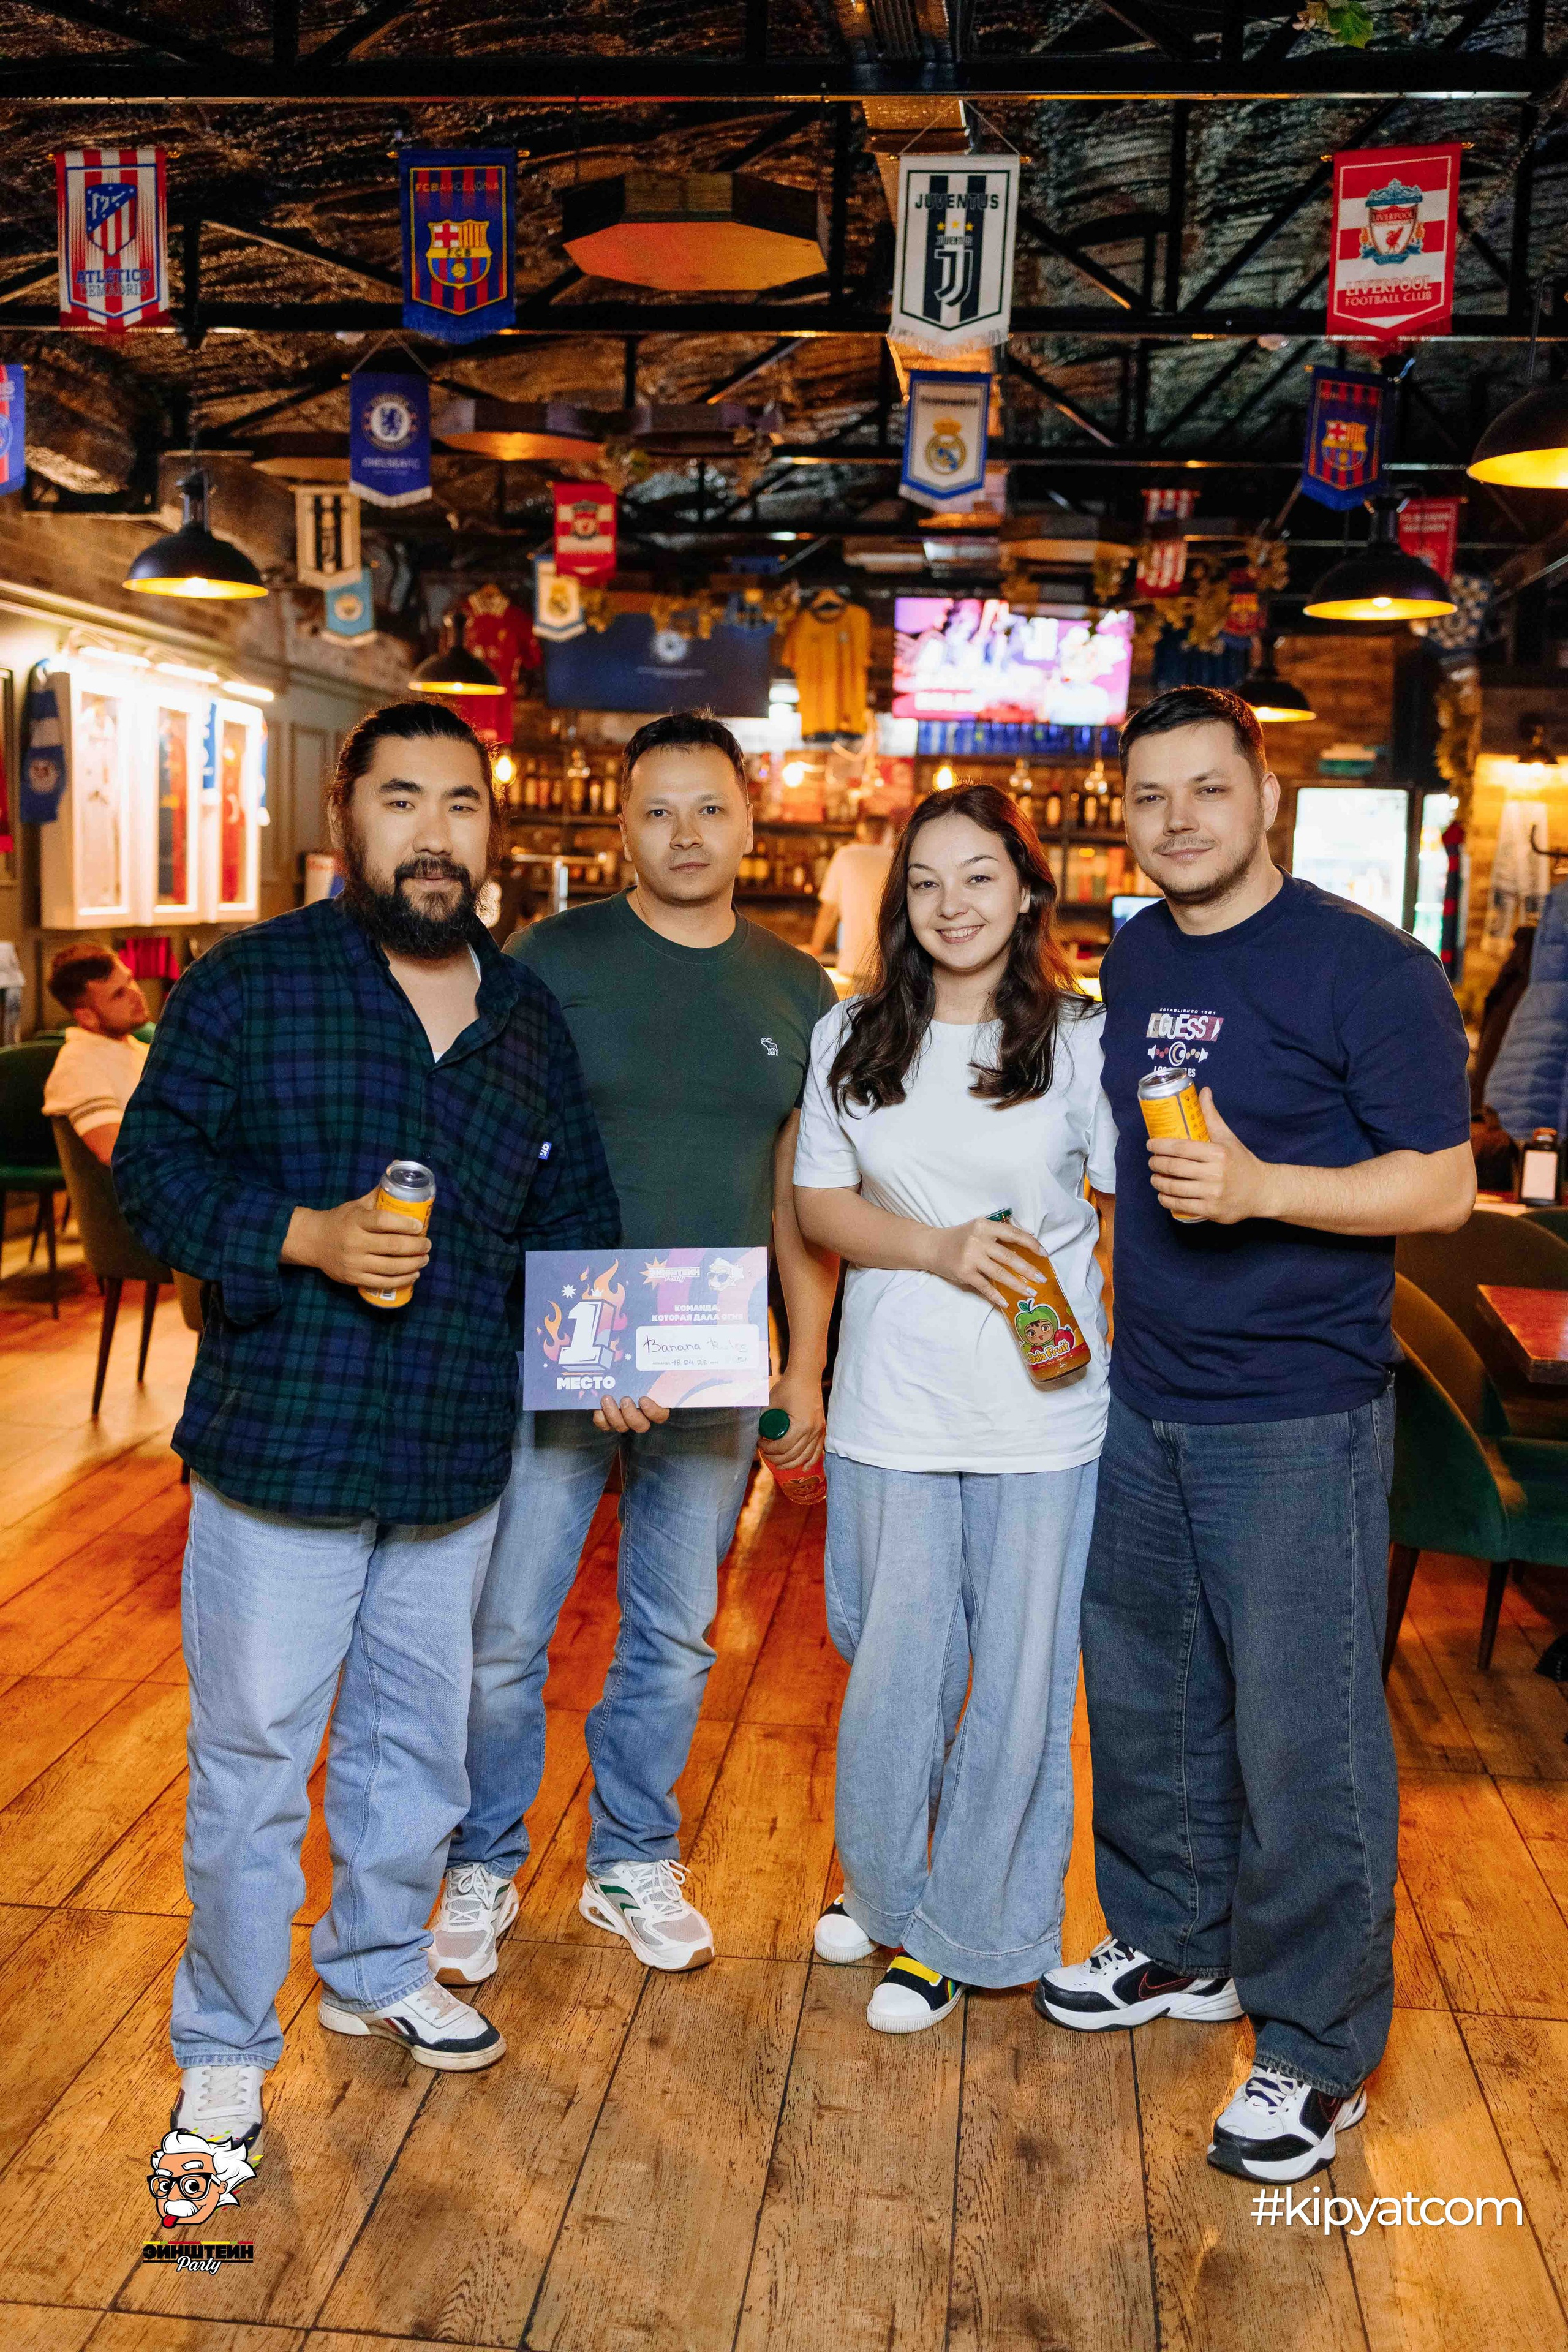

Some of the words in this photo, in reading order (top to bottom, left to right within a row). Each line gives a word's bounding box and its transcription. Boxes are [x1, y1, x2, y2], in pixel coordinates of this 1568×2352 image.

[915, 192, 1000, 209] JUVENTUS
[1346, 275, 1432, 296] LIVERPOOL
[1345, 294, 1400, 306] FOOTBALL
[1403, 290, 1433, 302] CLUB
[1158, 1012, 1209, 1041] GUESS
[558, 1300, 610, 1368] 1
[643, 1335, 701, 1354] Banana
[1028, 1351, 1047, 1364] Dala
[1046, 1340, 1069, 1359] Fruit
[556, 1376, 616, 1390] МЕСТО
